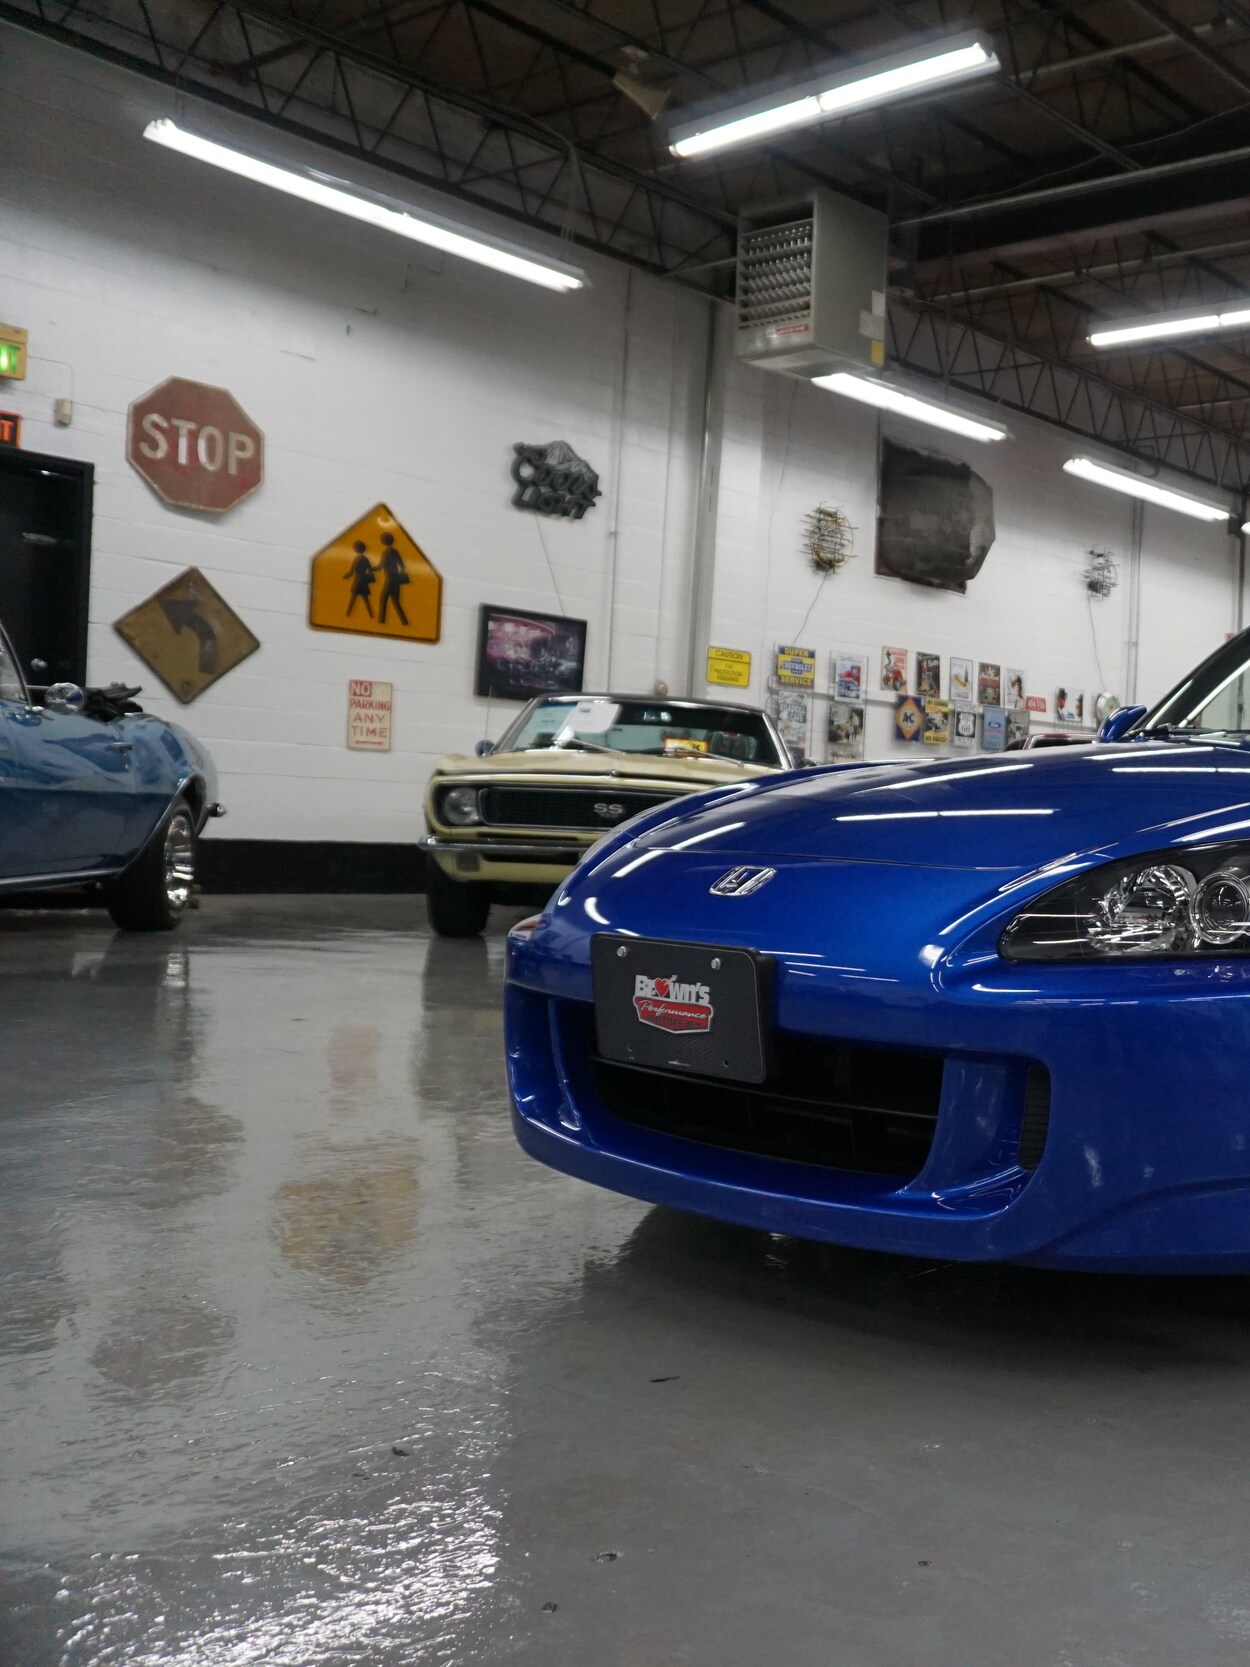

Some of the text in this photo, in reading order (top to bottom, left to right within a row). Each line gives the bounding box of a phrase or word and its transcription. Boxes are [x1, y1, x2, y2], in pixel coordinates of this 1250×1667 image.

[139, 413, 255, 475] STOP
[715, 650, 743, 660] CAUTION
[784, 647, 809, 657] SUPER
[781, 661, 812, 672] CHEVROLET
[780, 675, 812, 687] SERVICE
[351, 681, 371, 696] NO
[350, 698, 391, 711] PARKING
[353, 712, 386, 723] ANY
[352, 725, 387, 738] TIME
[961, 724, 971, 734] 66
[594, 803, 622, 813] SS
[639, 999, 708, 1019] Performance
